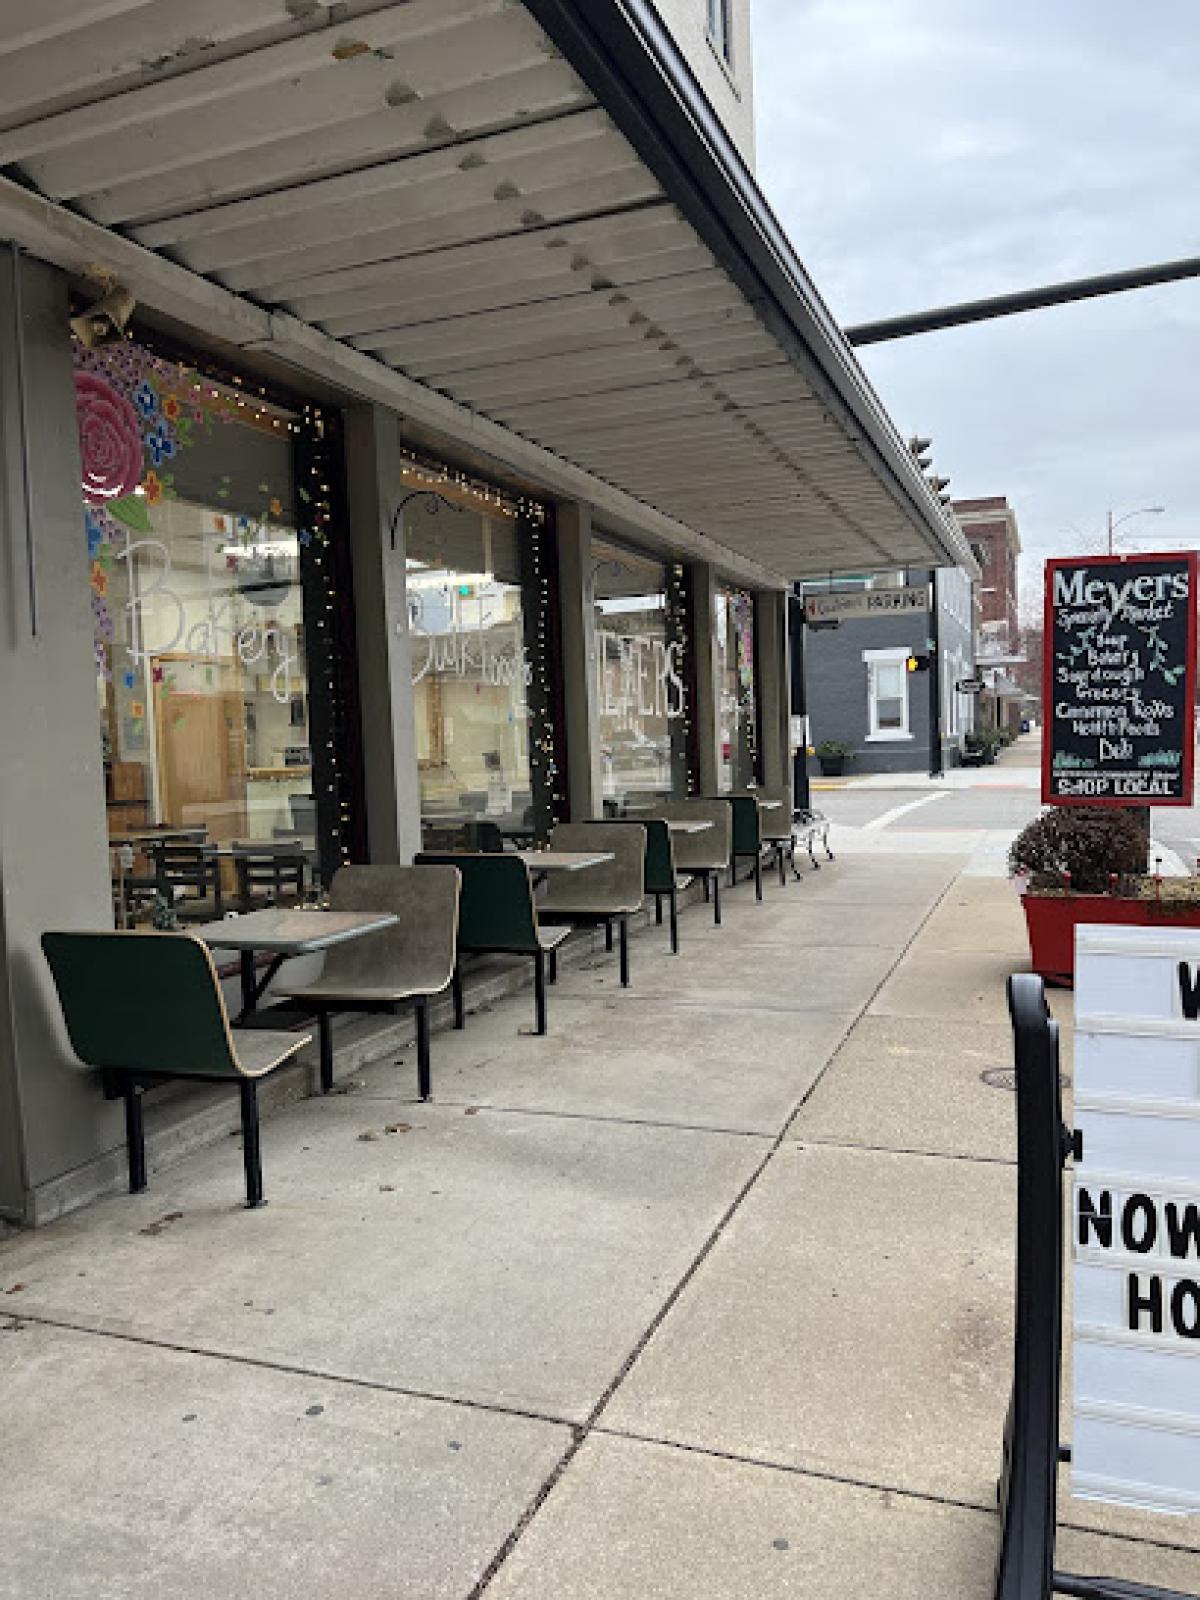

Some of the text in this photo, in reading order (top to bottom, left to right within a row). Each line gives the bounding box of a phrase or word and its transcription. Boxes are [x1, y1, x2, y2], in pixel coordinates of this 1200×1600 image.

[867, 588, 925, 611] PARKING
[1053, 570, 1189, 616] Meyers
[115, 540, 298, 703] Bakery
[594, 630, 685, 718] EYERS
[1088, 649, 1140, 669] Bakery
[1057, 777, 1175, 795] SHOP LOCAL
[1079, 1188, 1200, 1259] NOW
[1129, 1273, 1200, 1338] HO
